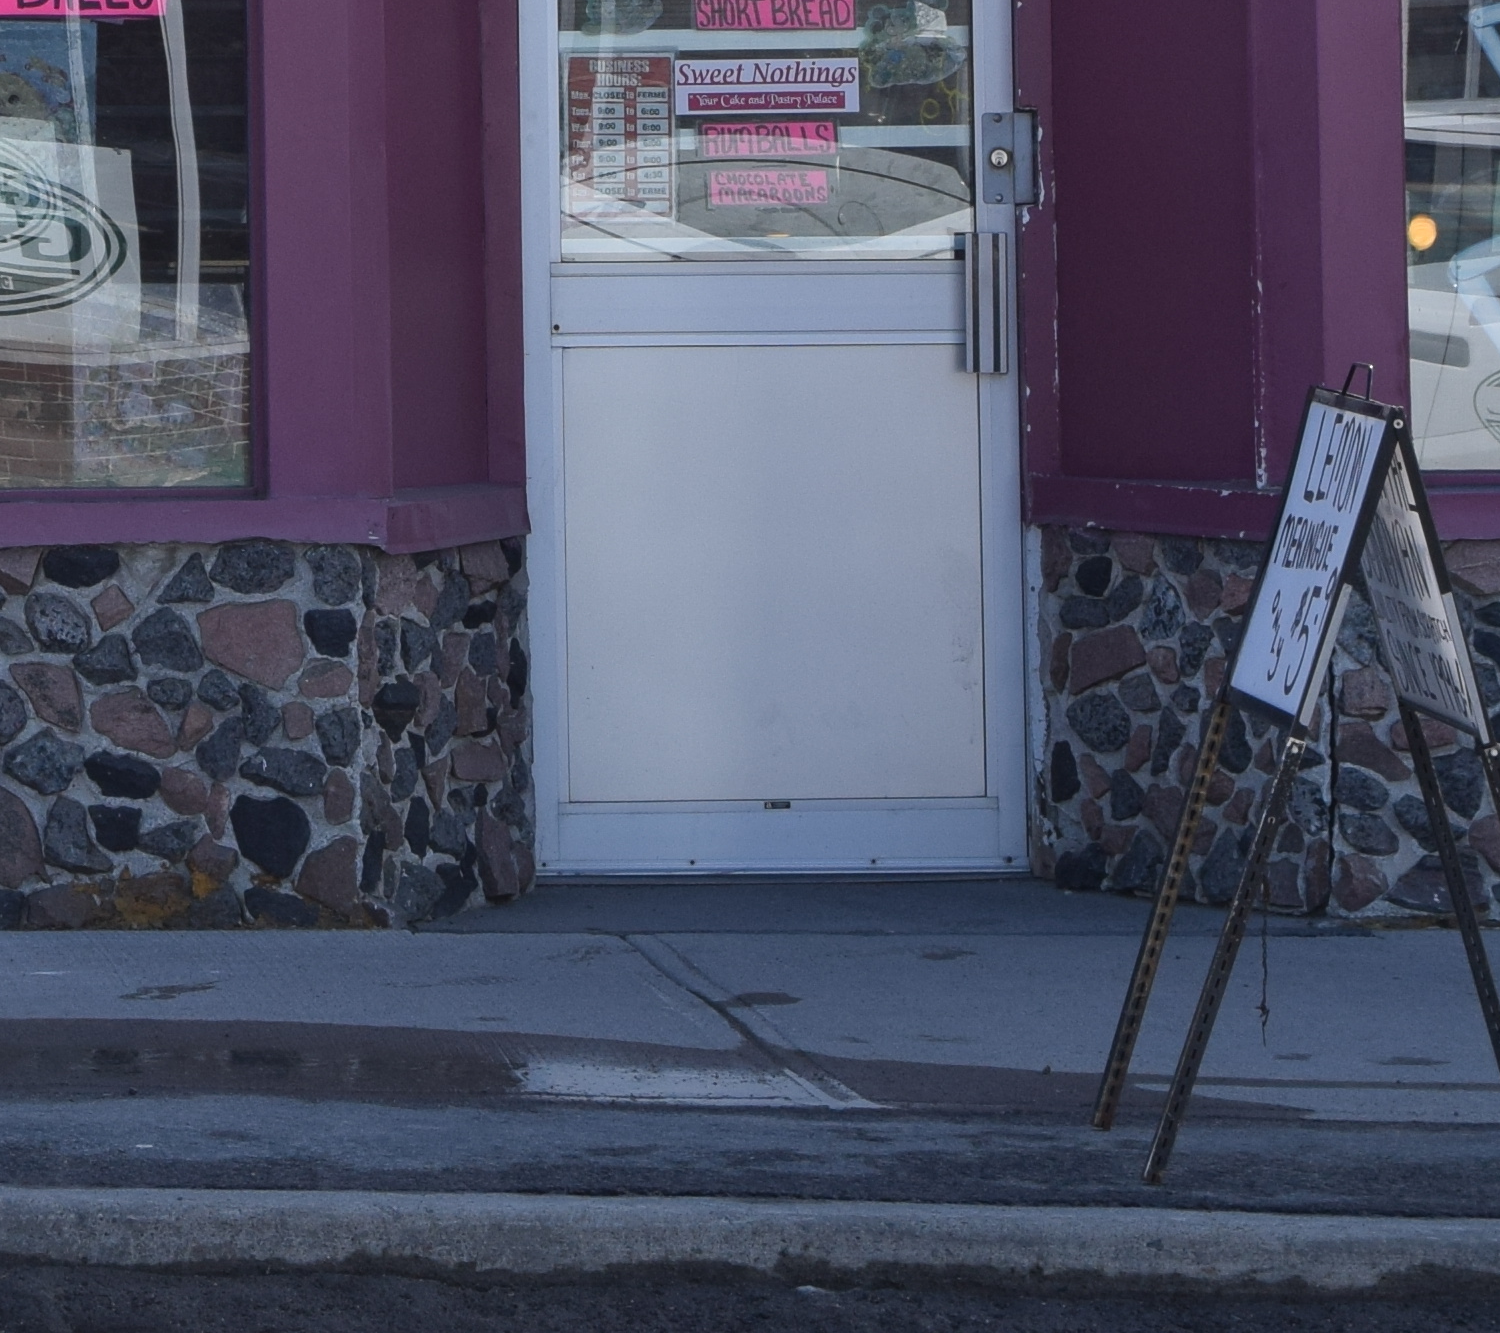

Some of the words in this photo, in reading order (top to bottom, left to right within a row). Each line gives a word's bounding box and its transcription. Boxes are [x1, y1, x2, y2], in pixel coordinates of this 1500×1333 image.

[589, 59, 650, 73] BUSINESS
[677, 63, 745, 85] Sweet
[752, 61, 857, 87] Nothings
[596, 73, 643, 86] HOURS:
[720, 94, 746, 107] Cake
[748, 94, 765, 105] and
[767, 93, 802, 109] Pastry
[714, 172, 812, 187] CHOCOLATE
[718, 187, 828, 204] MACAROONS
[1304, 410, 1373, 514] LEMON
[1273, 513, 1339, 572] MERINGUE
